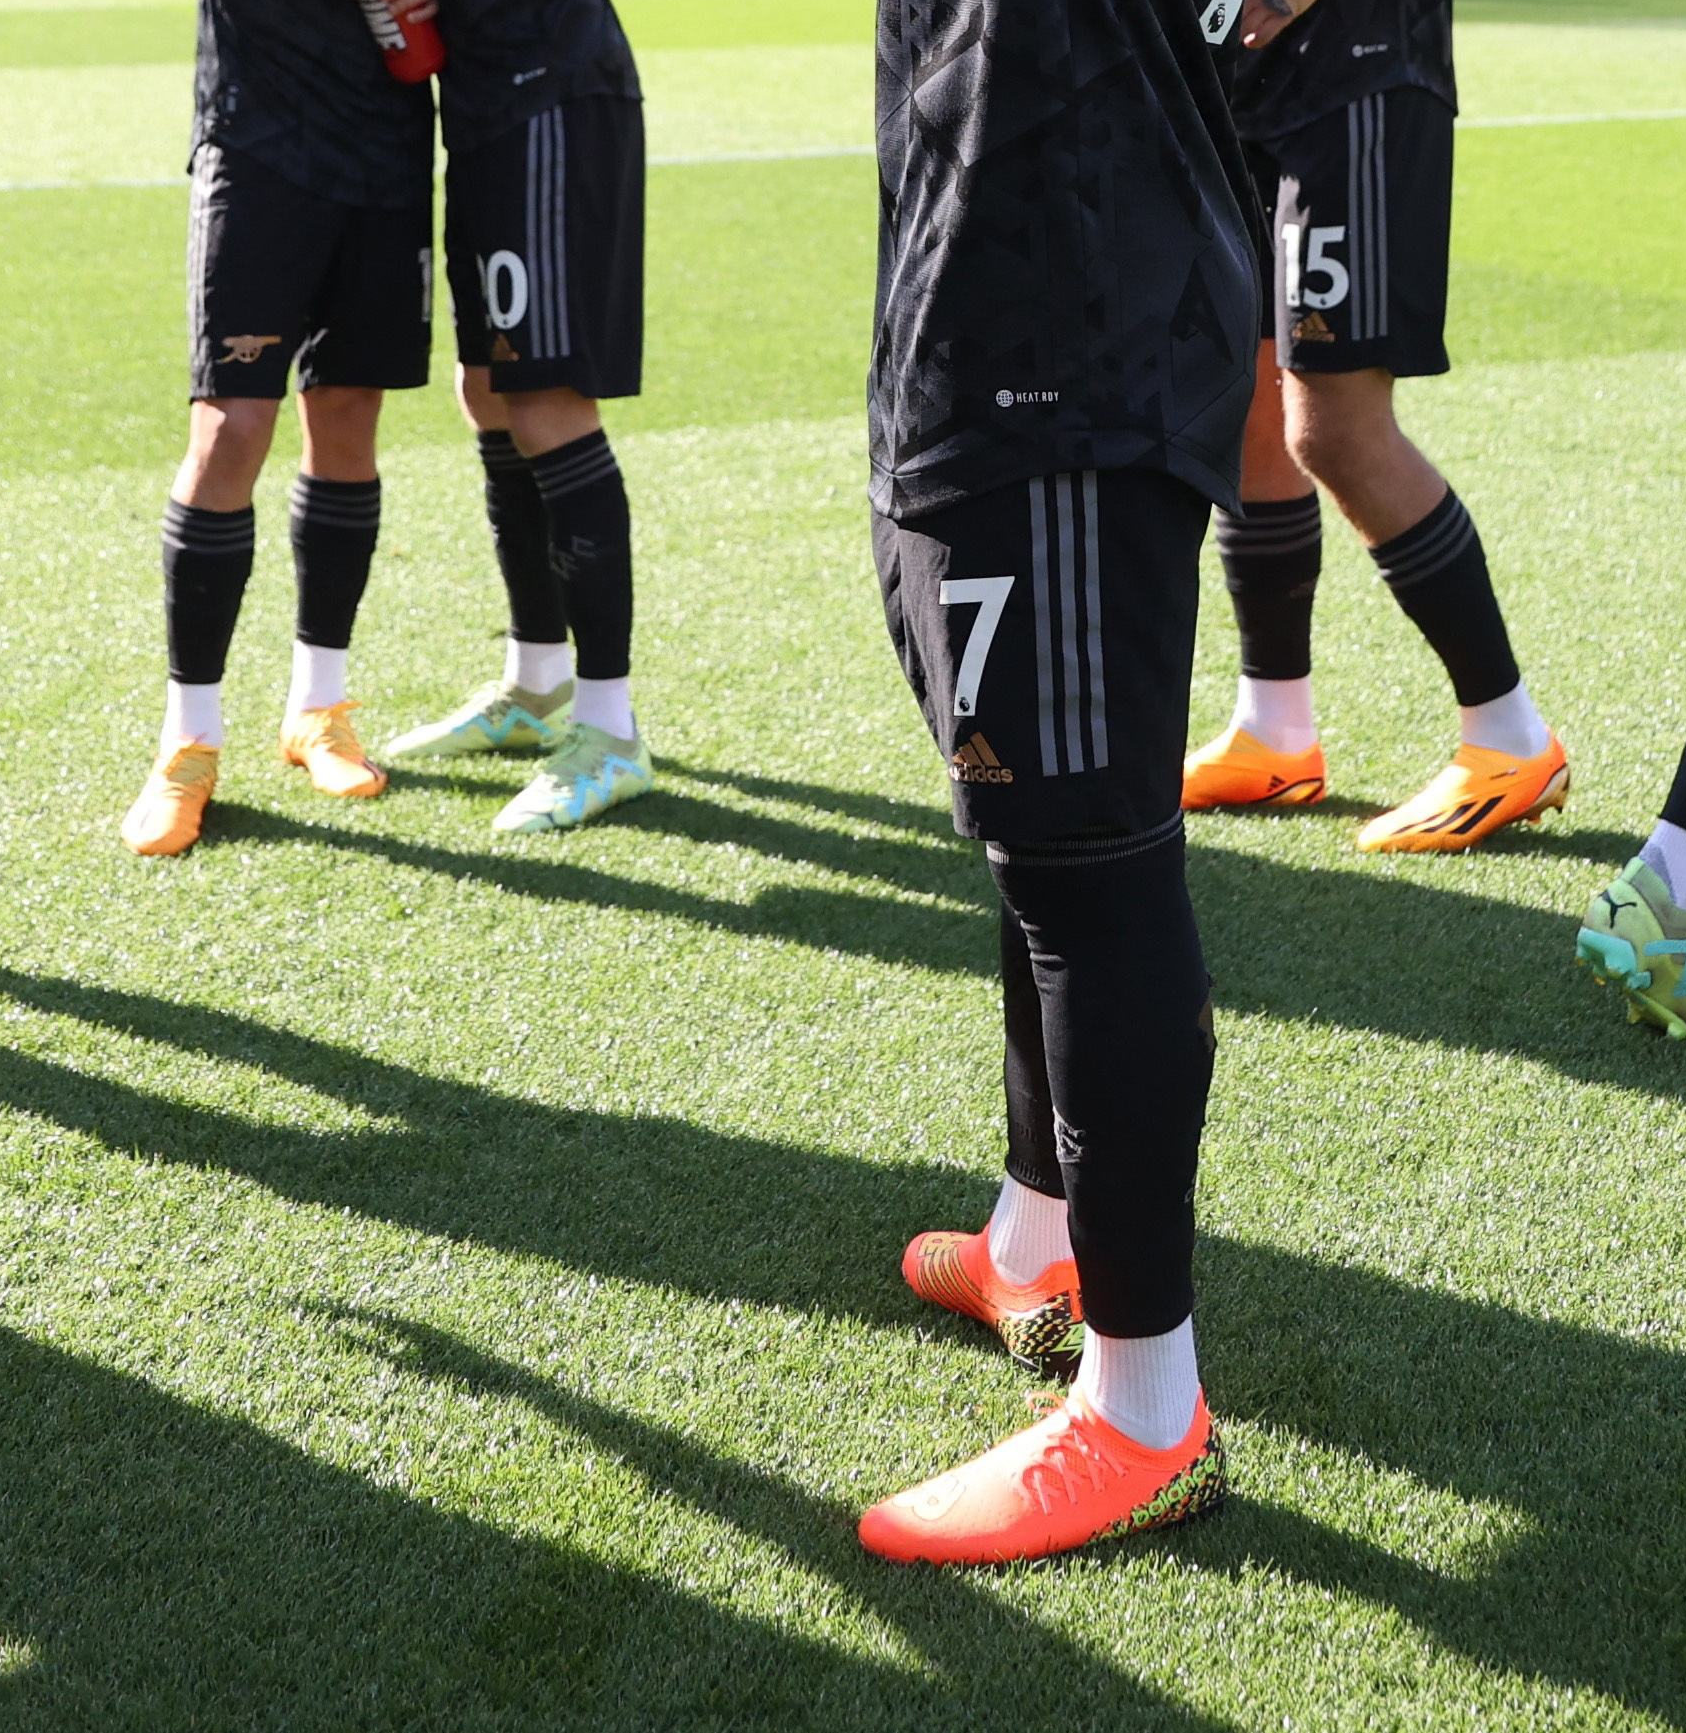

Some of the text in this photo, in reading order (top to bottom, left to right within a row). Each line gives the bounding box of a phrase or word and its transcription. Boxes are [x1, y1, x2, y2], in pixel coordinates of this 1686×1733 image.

[1280, 222, 1350, 310] 15
[1016, 391, 1059, 403] HEAT.RDY
[938, 575, 1016, 717] 7
[1131, 1451, 1217, 1527] balance
